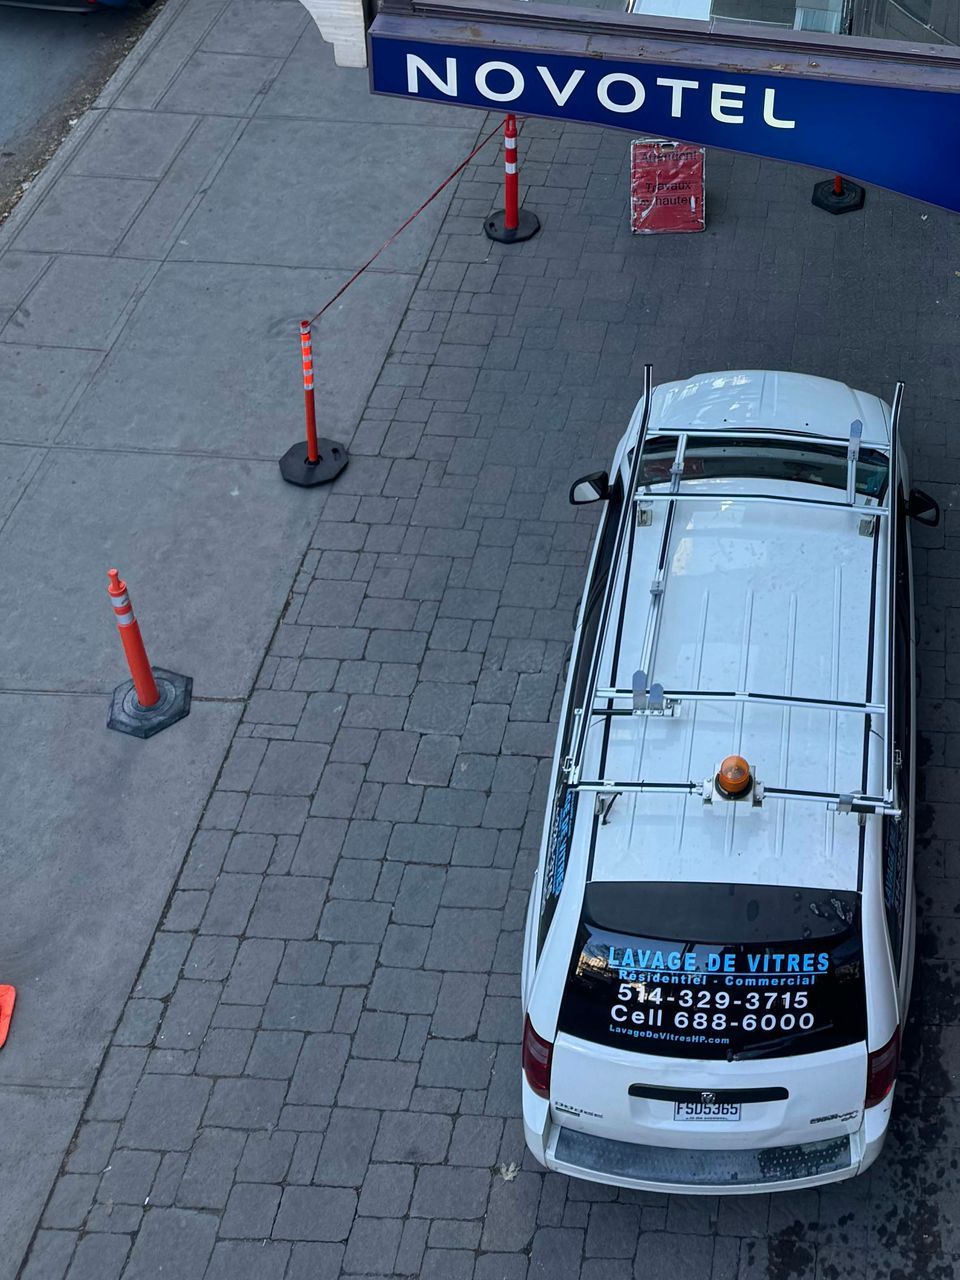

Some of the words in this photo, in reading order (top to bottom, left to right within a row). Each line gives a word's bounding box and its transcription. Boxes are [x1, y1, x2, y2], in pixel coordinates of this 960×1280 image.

[406, 53, 796, 129] NOVOTEL
[646, 182, 691, 192] Travaux
[608, 946, 697, 971] LAVAGE
[708, 953, 736, 971] DE
[747, 952, 830, 972] VITRES
[618, 970, 707, 985] Résidentiel
[725, 975, 815, 986] Commercial
[617, 983, 809, 1010] 514-329-3715
[610, 1004, 663, 1027] Cell
[674, 1011, 815, 1031] 688-6000
[609, 1024, 730, 1044] LavageDeVitresHP.com
